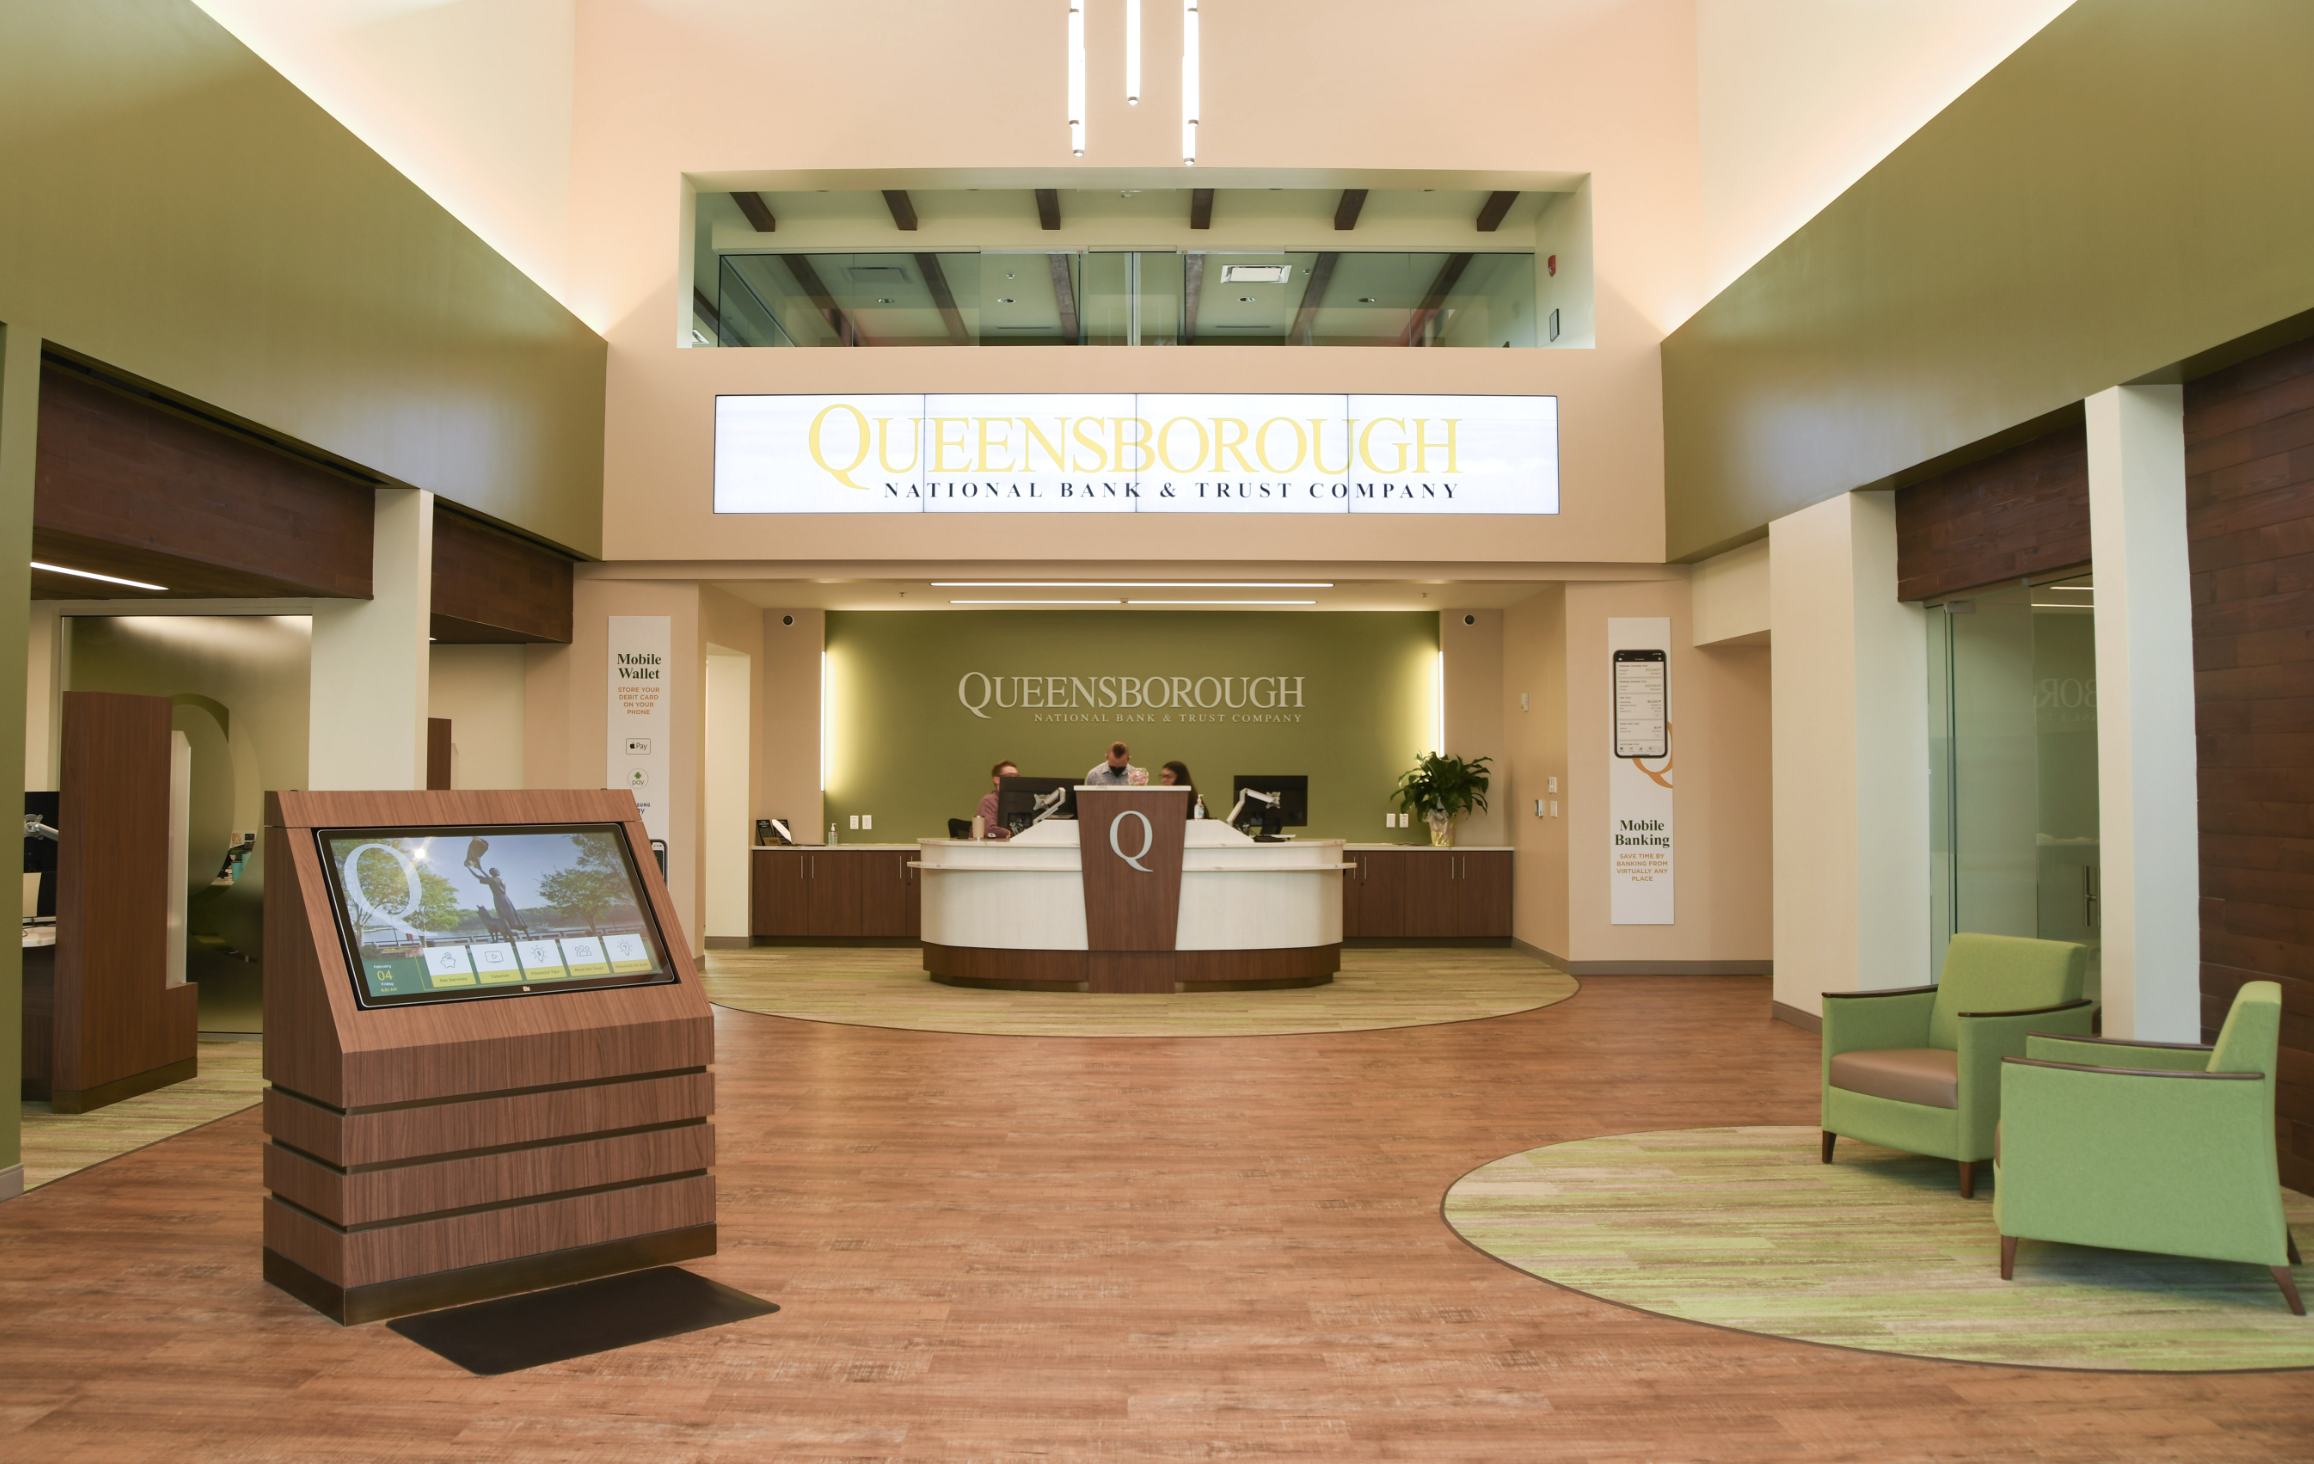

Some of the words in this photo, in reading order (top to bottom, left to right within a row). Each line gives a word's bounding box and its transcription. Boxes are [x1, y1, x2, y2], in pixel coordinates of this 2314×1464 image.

[808, 403, 1461, 490] QUEENSBOROUGH
[884, 482, 1042, 498] NATIONAL
[1060, 482, 1141, 498] BANK
[1159, 482, 1177, 498] &
[1195, 482, 1292, 498] TRUST
[1309, 482, 1458, 498] COMPANY
[617, 653, 661, 665] Mobile
[618, 667, 660, 679] Wallet
[958, 671, 1306, 719] QUEENSBOROUGH
[1034, 713, 1110, 723] NATIONAL
[1116, 713, 1155, 723] BANK
[1162, 713, 1172, 723] &
[1179, 713, 1226, 723] TRUST
[1232, 713, 1302, 723] COMPANY
[635, 742, 648, 751] Pay
[1620, 819, 1665, 831] Mobile
[1109, 810, 1154, 873] Q
[1614, 834, 1671, 848] Banking
[343, 843, 437, 936] Q
[377, 970, 393, 981] 04
